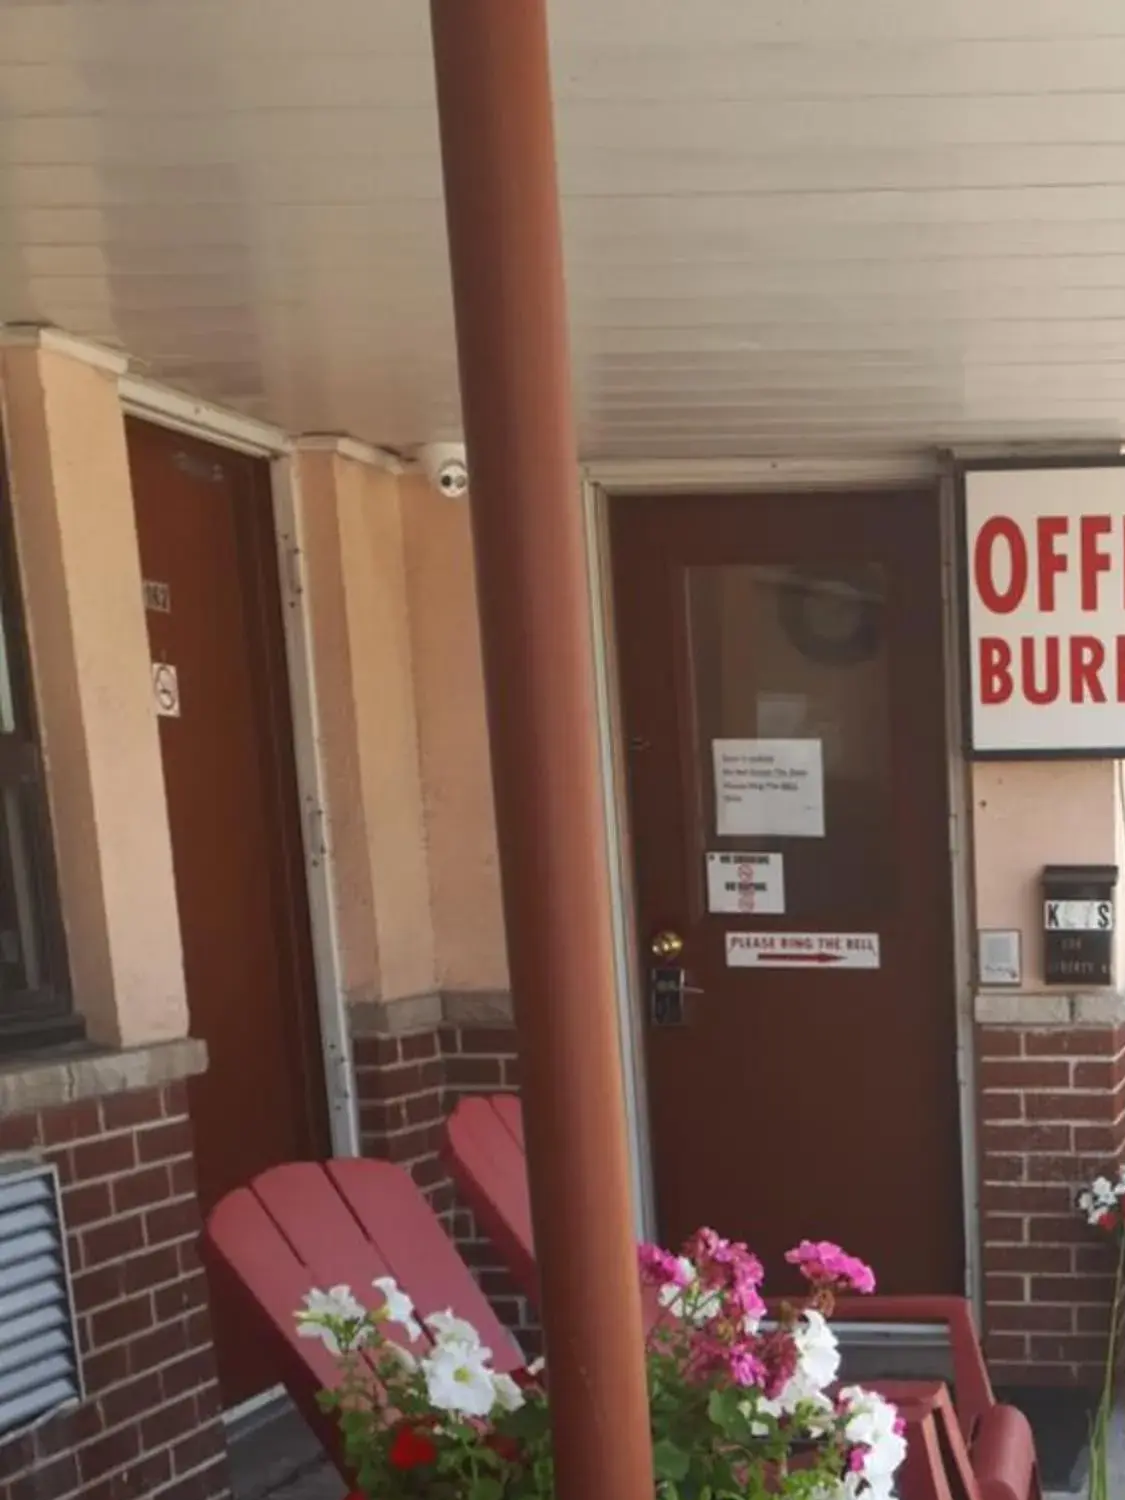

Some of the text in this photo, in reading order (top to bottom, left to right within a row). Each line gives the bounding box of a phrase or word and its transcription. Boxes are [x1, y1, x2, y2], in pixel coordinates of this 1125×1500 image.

[729, 937, 875, 952] PLEASE RING THE BELL
